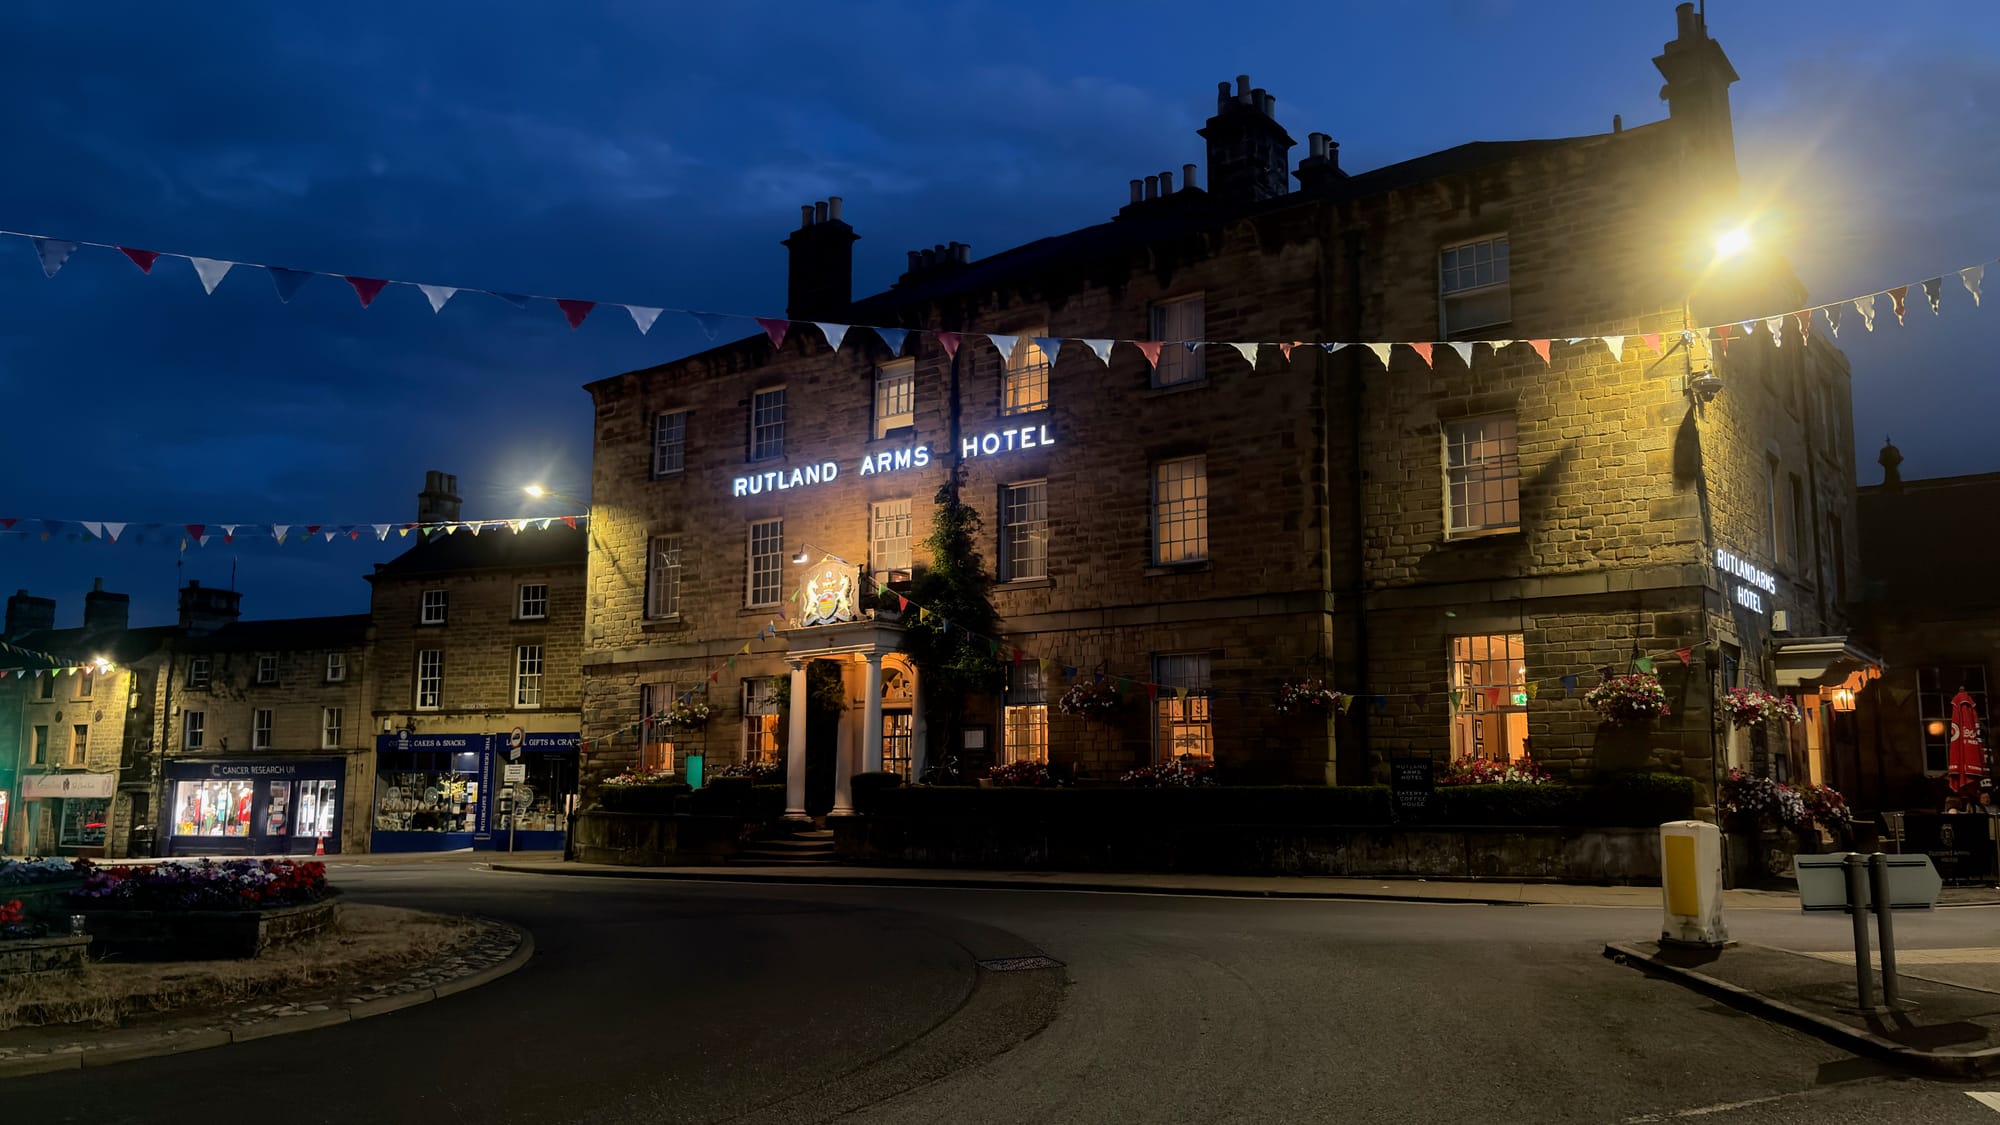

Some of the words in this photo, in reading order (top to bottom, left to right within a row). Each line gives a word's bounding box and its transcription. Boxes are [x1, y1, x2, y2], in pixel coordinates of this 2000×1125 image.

[733, 461, 838, 497] RUTLAND
[860, 446, 929, 475] ARMS
[962, 424, 1056, 459] HOTEL
[1717, 549, 1756, 584] RUTLAND
[1755, 569, 1776, 595] ARMS
[1737, 585, 1763, 615] HOTEL
[413, 739, 435, 747] CAKES
[443, 739, 466, 747] SNACKS
[528, 738, 549, 746] GIFTS
[222, 766, 250, 775] CANCER
[251, 765, 285, 775] RESEARCH
[286, 765, 296, 774] UK
